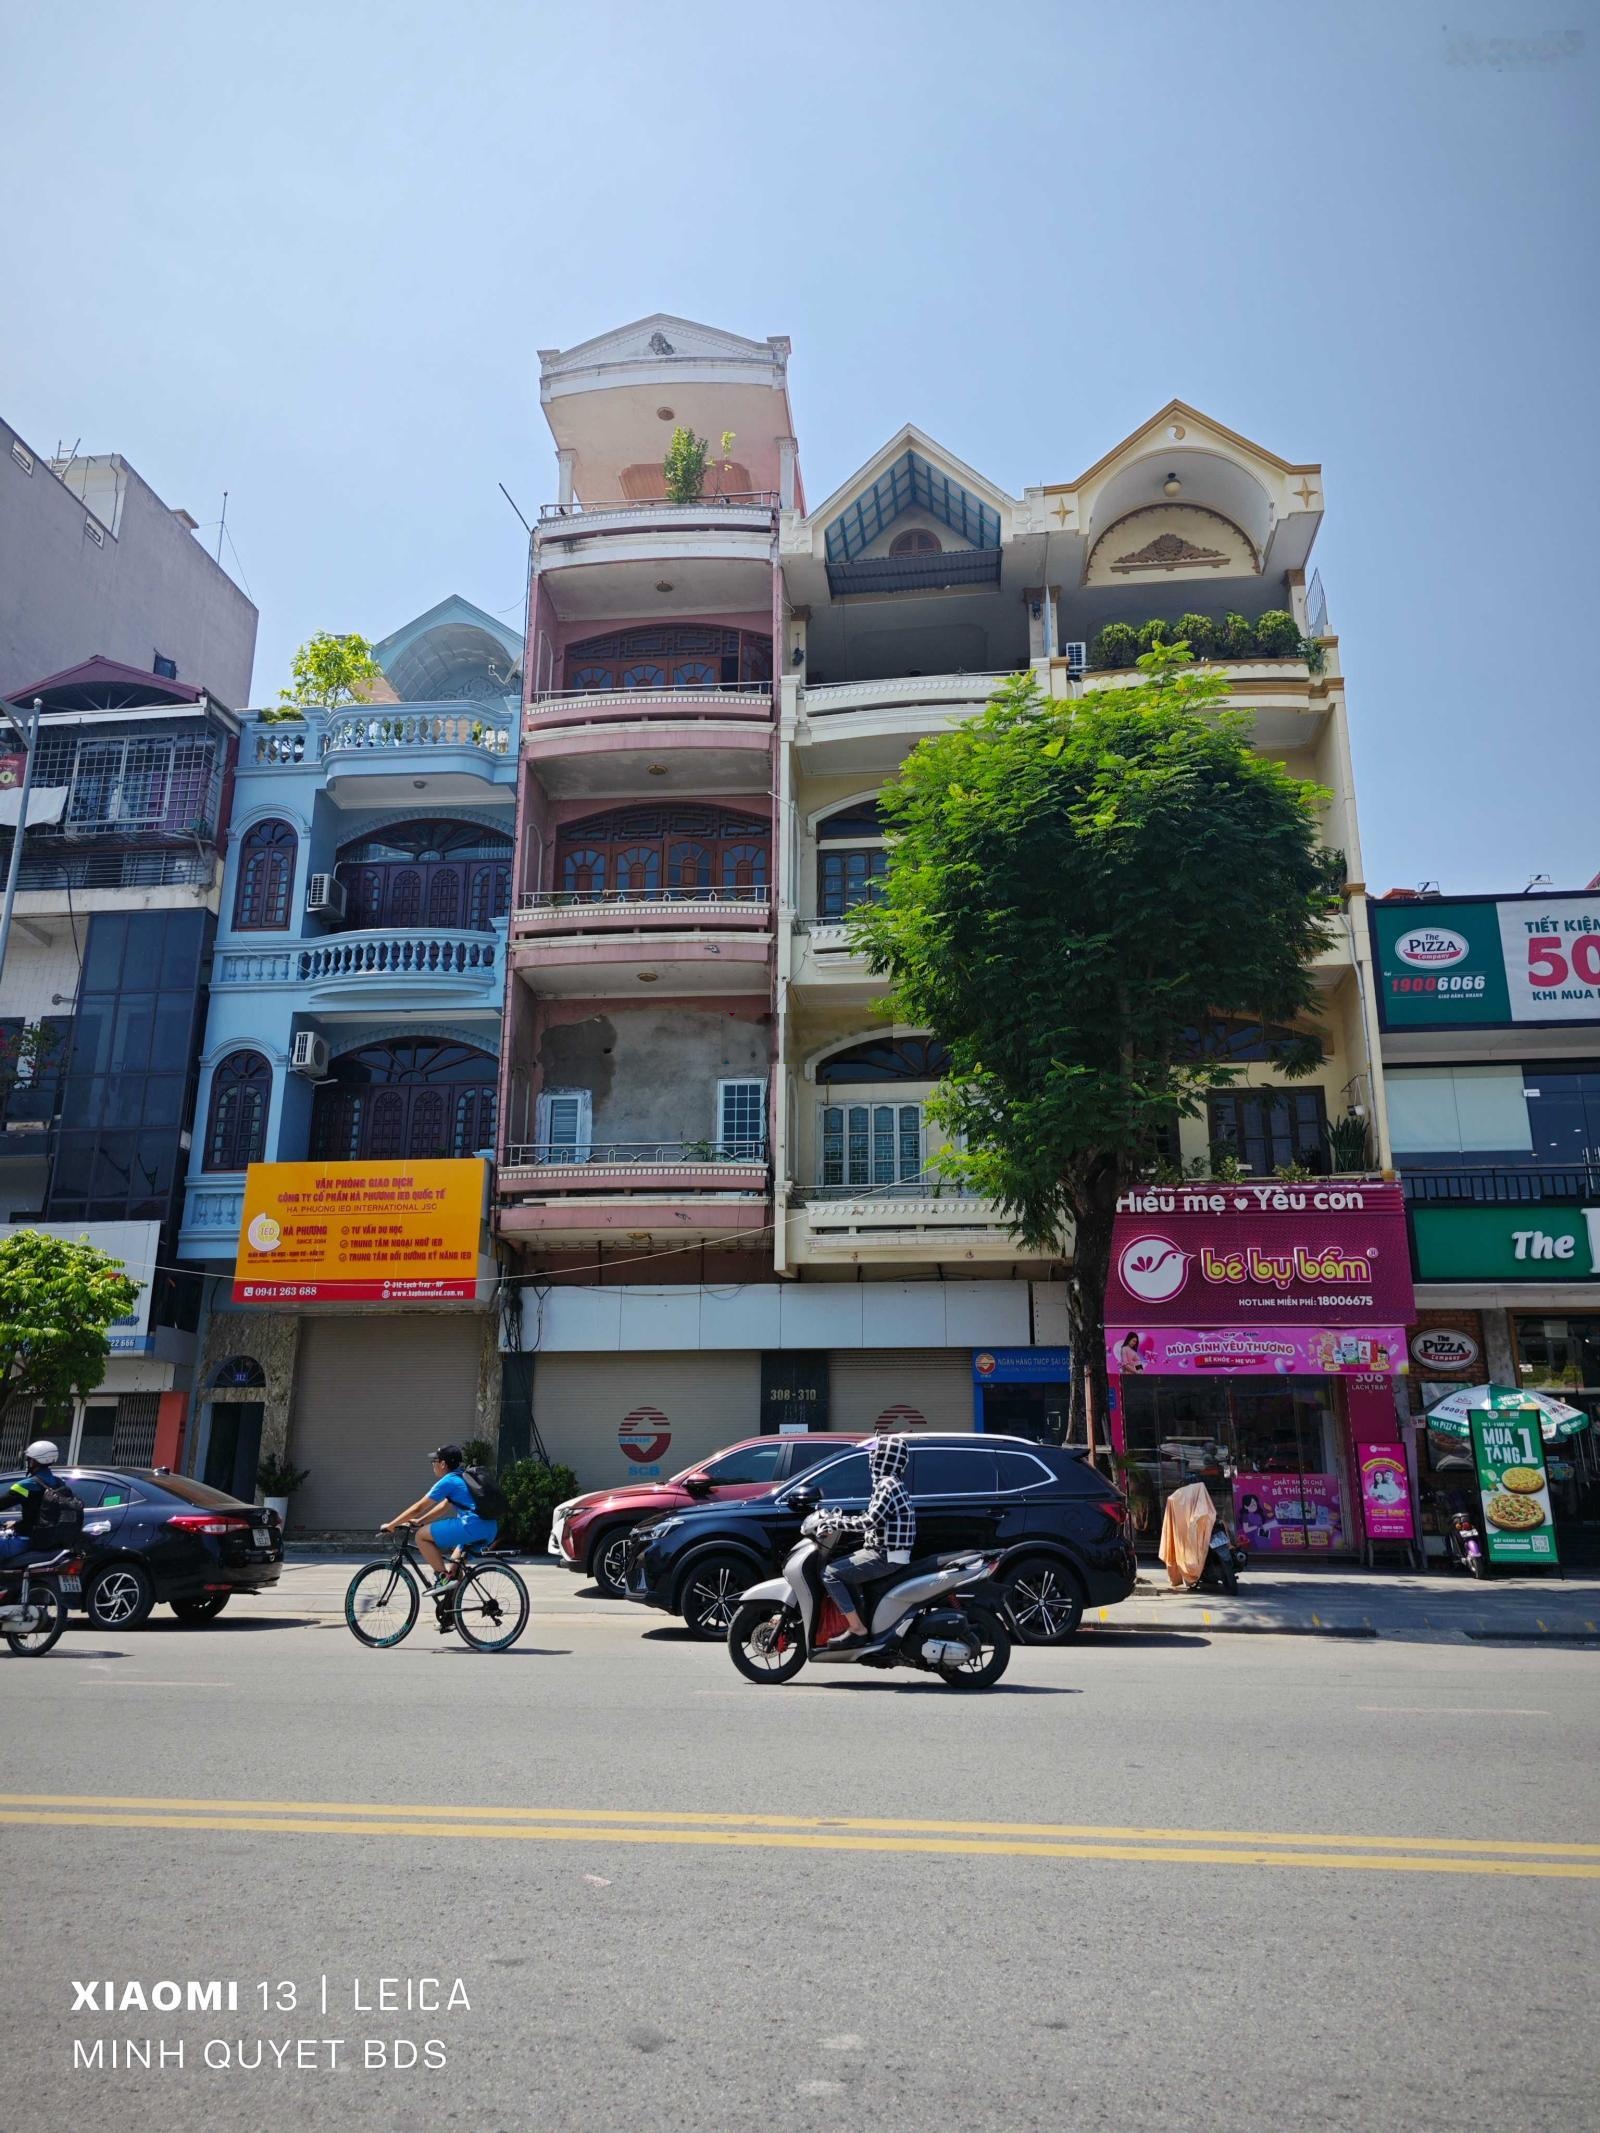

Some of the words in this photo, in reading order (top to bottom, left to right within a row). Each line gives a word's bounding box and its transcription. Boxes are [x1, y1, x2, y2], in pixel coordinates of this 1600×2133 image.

[1524, 915, 1559, 933] TIẾT
[1425, 933, 1439, 941] The
[1408, 938, 1457, 953] PIZZA
[1417, 953, 1450, 961] Company
[1532, 990, 1557, 1001] KHI
[1561, 989, 1594, 1000] MUA
[335, 1177, 366, 1189] PHÒNG
[368, 1178, 390, 1188] GIAO
[391, 1177, 413, 1189] DỊCH
[301, 1193, 312, 1202] TY
[397, 1191, 410, 1200] IED
[1184, 1194, 1226, 1216] mẹ
[1253, 1188, 1306, 1210] Yêu
[1313, 1192, 1364, 1210] con
[338, 1204, 352, 1212] IED
[353, 1202, 419, 1212] INTERNATIONAL
[421, 1202, 437, 1210] JSC
[261, 1227, 275, 1235] IED
[378, 1225, 388, 1234] DU
[351, 1239, 373, 1248] TRUNG
[431, 1238, 443, 1247] IED
[1511, 1230, 1575, 1260] The
[349, 1253, 372, 1262] TRUNG
[460, 1251, 472, 1260] IED
[1201, 1247, 1248, 1284] bé
[1247, 1247, 1295, 1290] bụ
[254, 1287, 277, 1297] 0941
[279, 1286, 297, 1296] 263
[299, 1286, 317, 1296] 688
[1238, 1298, 1276, 1306] HOTLINE
[1316, 1295, 1374, 1306] 18006675
[1166, 1342, 1192, 1355] MÙA
[1194, 1342, 1221, 1353] SINH
[1222, 1340, 1244, 1351] YÊU
[1246, 1341, 1294, 1355] THƯƠNG
[1422, 1340, 1465, 1354] PIZZA
[1482, 1427, 1513, 1445] MUA
[1517, 1427, 1539, 1464] 1
[1484, 1445, 1521, 1467] TẶNG
[628, 1465, 661, 1477] SCB
